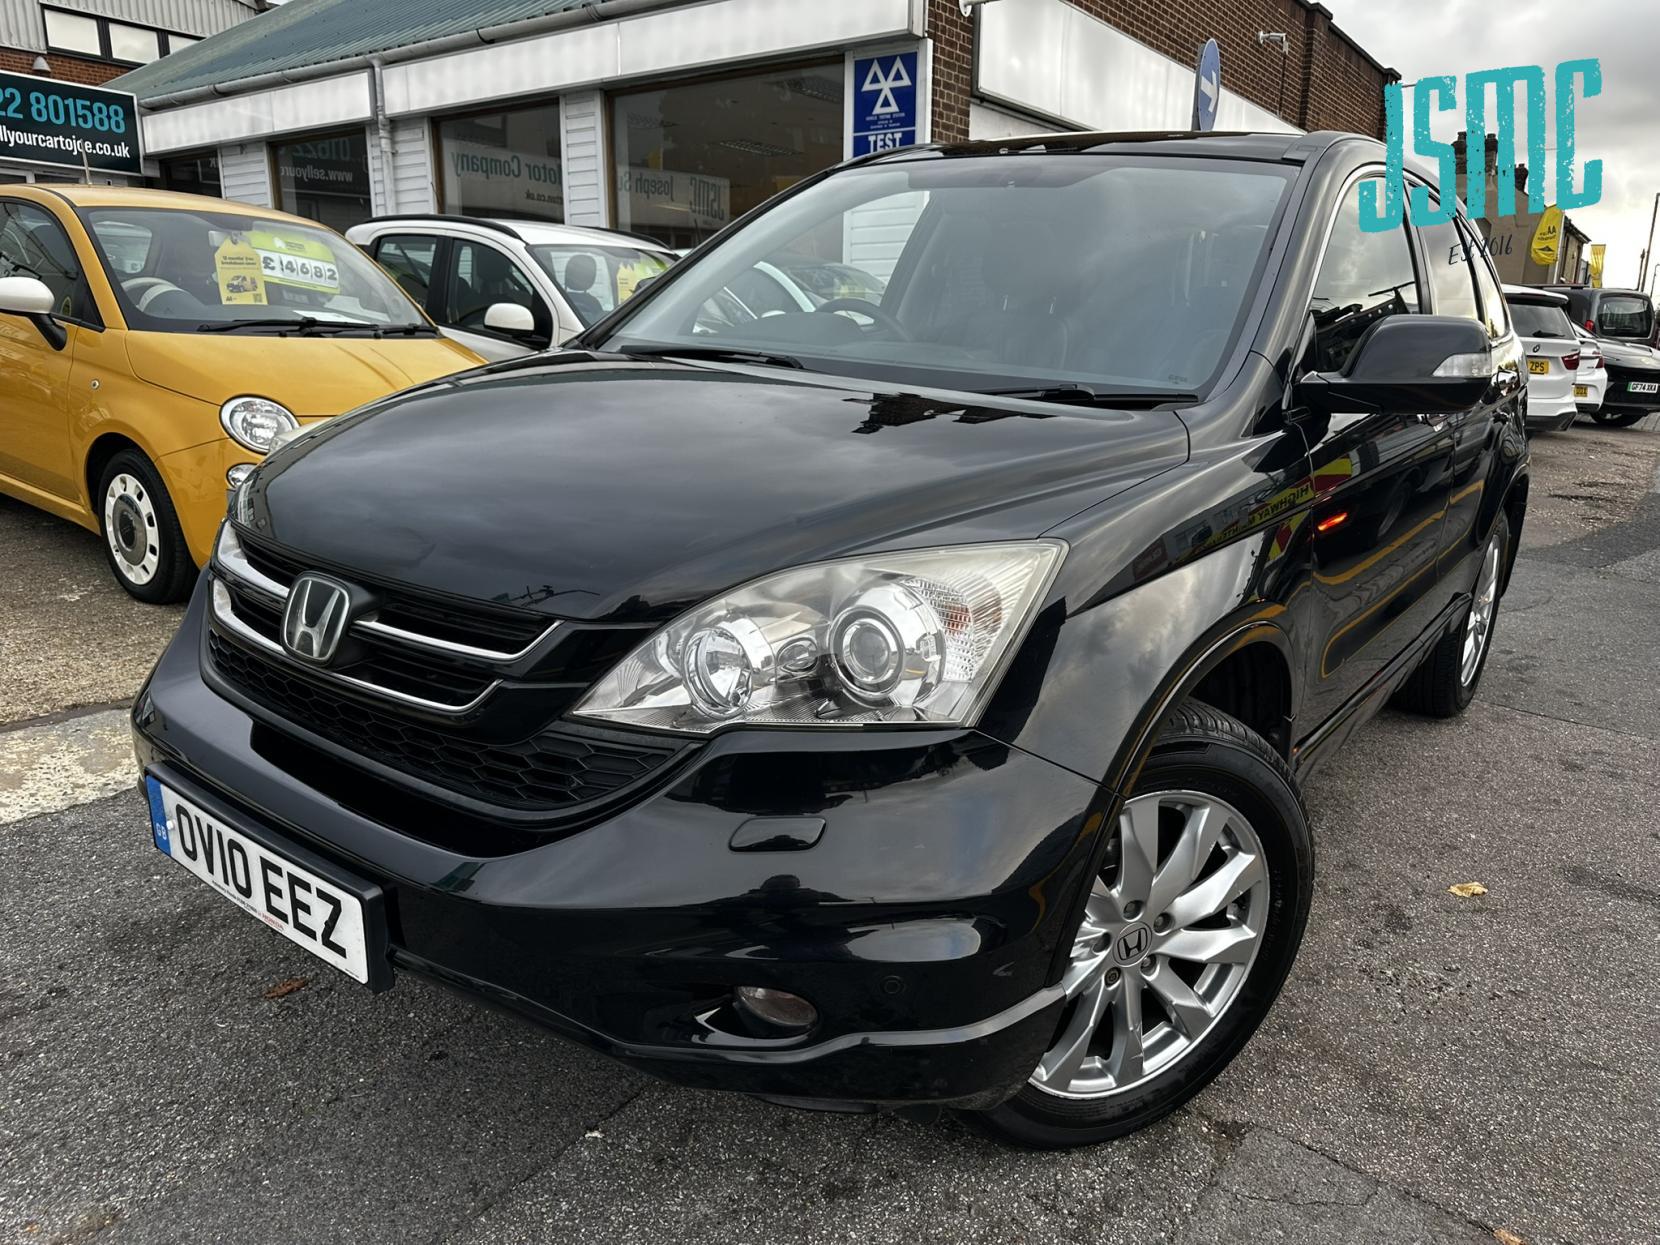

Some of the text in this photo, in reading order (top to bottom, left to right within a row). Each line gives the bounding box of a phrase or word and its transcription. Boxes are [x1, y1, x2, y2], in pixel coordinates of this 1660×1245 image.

[30, 91, 126, 134] 801588
[868, 132, 903, 154] TEST
[1529, 361, 1545, 372] ZPS
[155, 822, 168, 841] GB
[176, 803, 347, 959] OV10 EEZ
